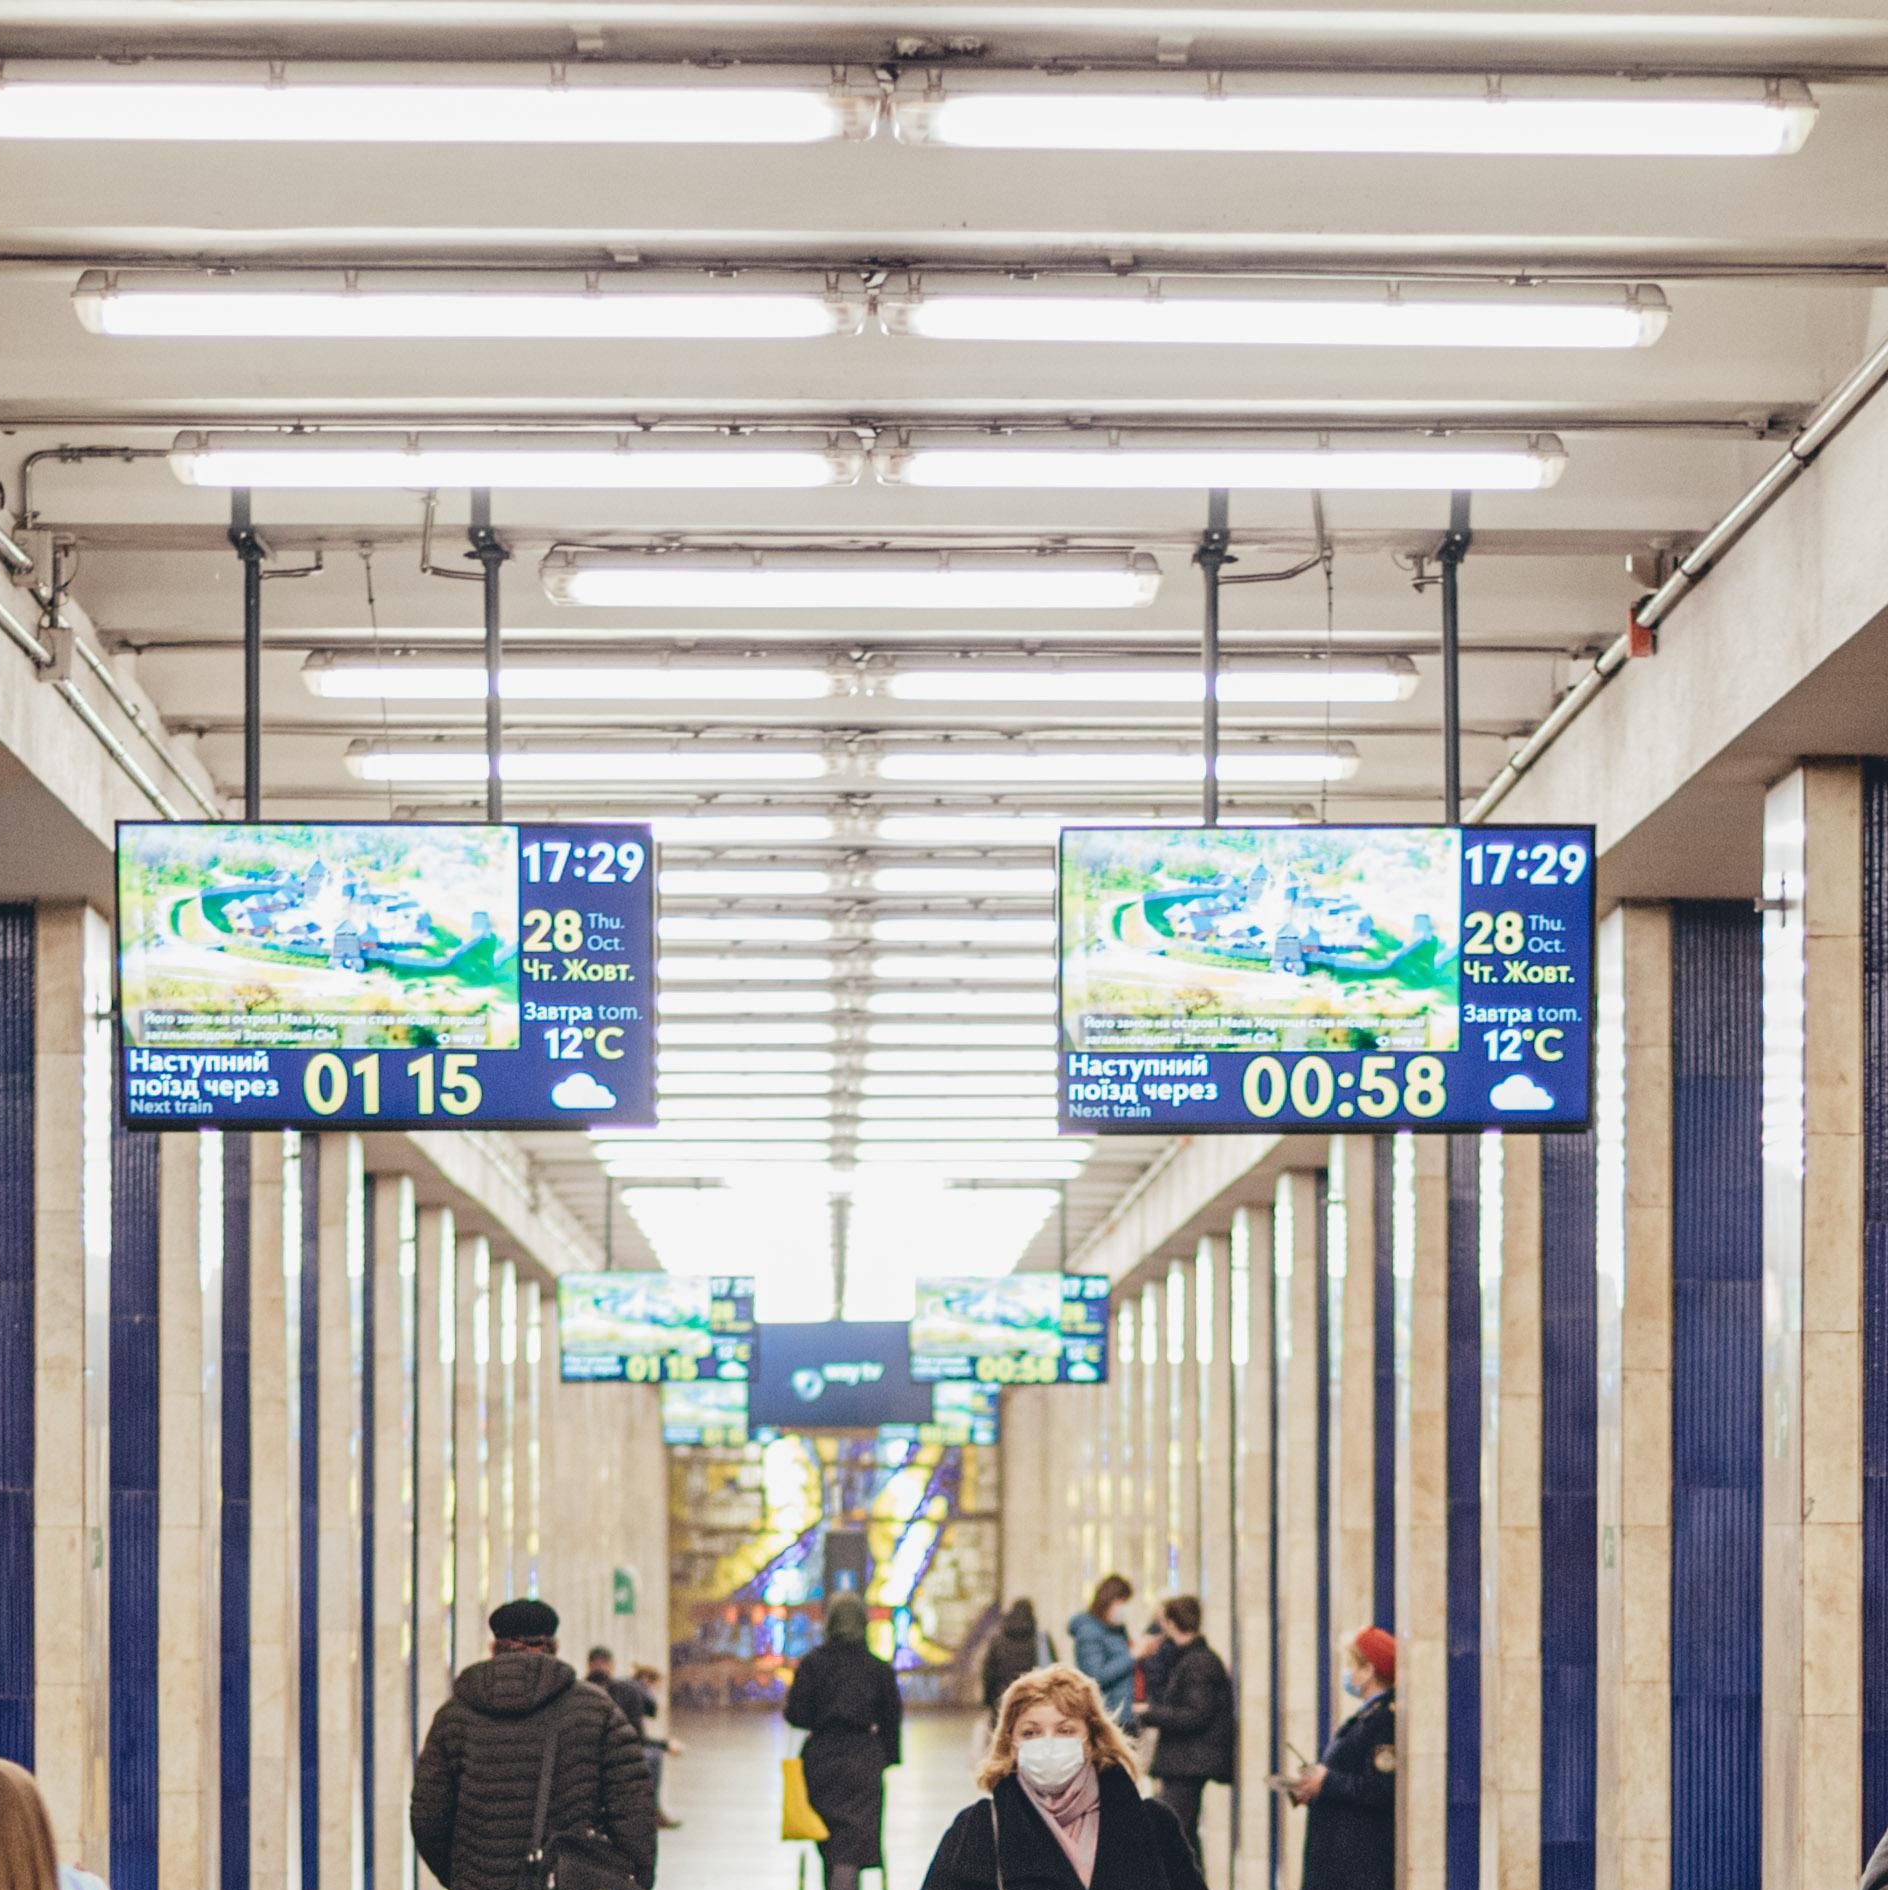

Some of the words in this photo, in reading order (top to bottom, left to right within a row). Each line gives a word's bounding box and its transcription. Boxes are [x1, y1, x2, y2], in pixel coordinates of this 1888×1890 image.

[522, 842, 645, 883] 17:29
[1464, 844, 1587, 885] 17:29
[522, 909, 583, 953] 28
[587, 913, 625, 929] Thu.
[587, 935, 625, 951] Oct.
[1463, 911, 1524, 955] 28
[1528, 915, 1566, 931] Thu.
[1528, 937, 1566, 953] Oct.
[522, 958, 558, 982] Чт.
[562, 958, 635, 982] Жовт.
[1463, 960, 1498, 983] Чт.
[1502, 960, 1575, 983] Жовт.
[524, 1002, 593, 1025] Завтра
[598, 1004, 643, 1021] tom.
[1463, 1004, 1533, 1027] Завтра
[1537, 1006, 1582, 1022] tom.
[543, 1026, 625, 1060] 12°C
[1483, 1028, 1564, 1062] 12°C
[129, 1050, 269, 1078] Наступний
[1068, 1054, 1208, 1082] Наступний
[129, 1073, 200, 1100] поїзд
[204, 1078, 279, 1103] через
[1068, 1078, 1138, 1104] поїзд
[1143, 1082, 1218, 1107] через
[1243, 1055, 1447, 1118] 00:58
[130, 1099, 171, 1114] Next
[174, 1099, 213, 1114] train
[1069, 1103, 1109, 1118] Next
[1113, 1103, 1151, 1118] train
